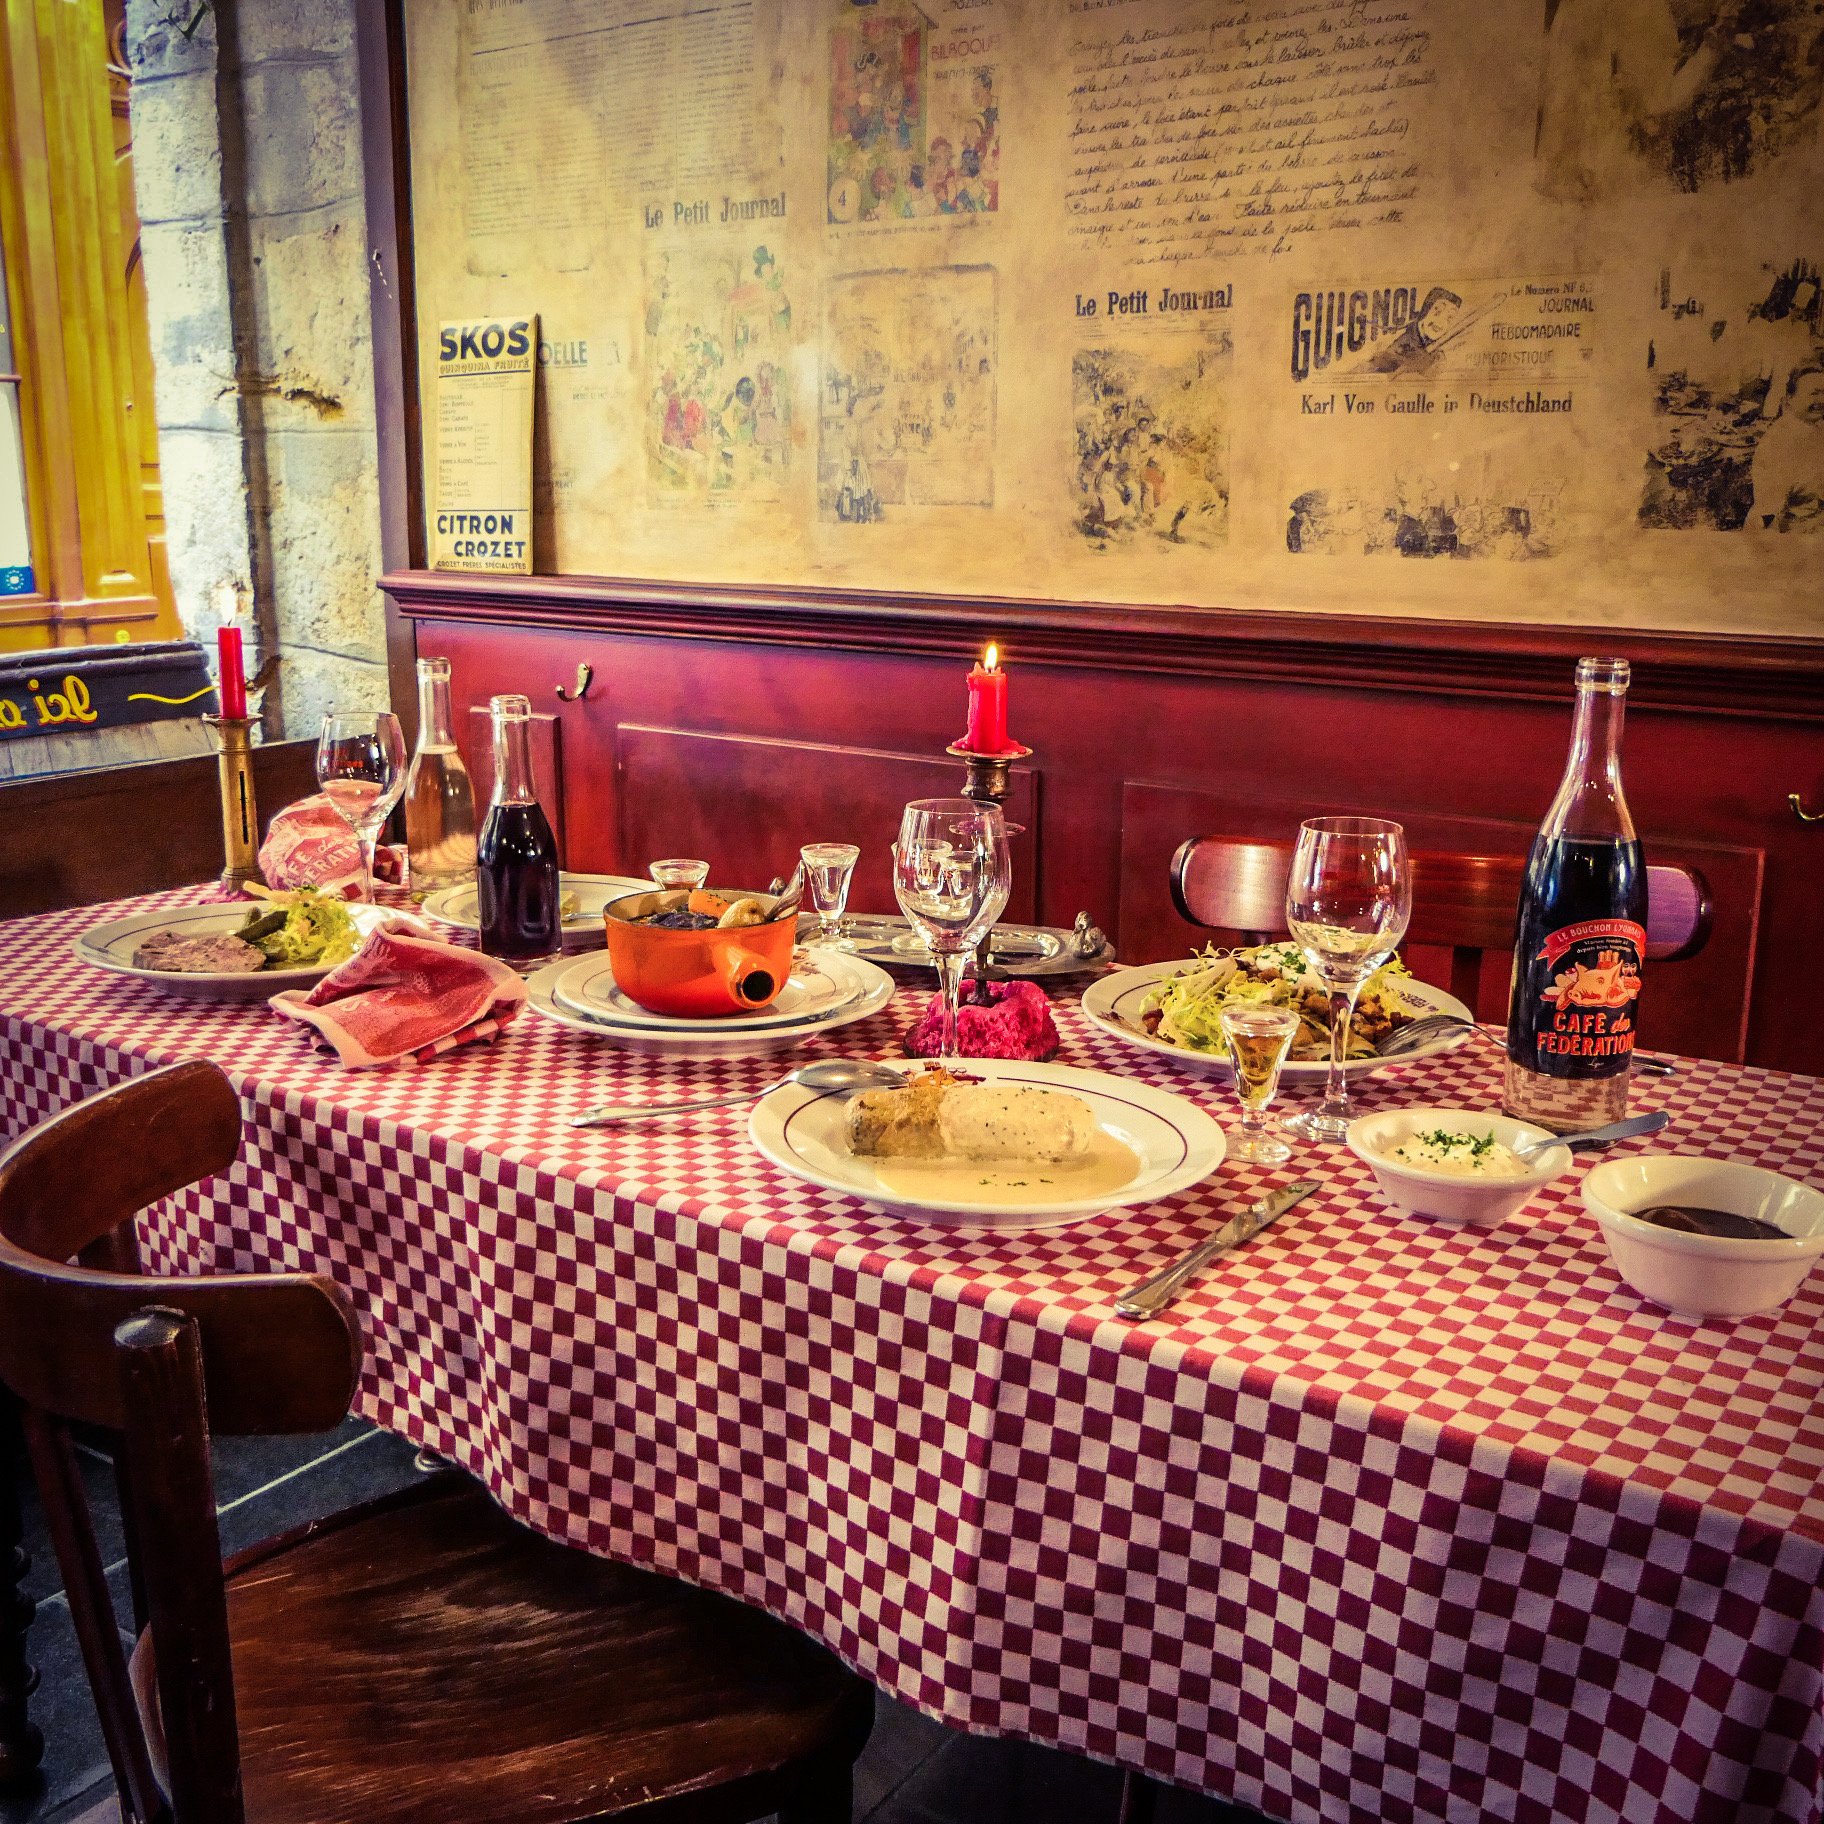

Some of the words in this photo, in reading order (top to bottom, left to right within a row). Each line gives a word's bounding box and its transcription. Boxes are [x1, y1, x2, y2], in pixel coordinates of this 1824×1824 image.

[645, 205, 664, 229] Le
[674, 199, 710, 224] Petit
[720, 191, 786, 222] Journal
[1075, 293, 1097, 318] Le
[1107, 289, 1148, 316] Petit
[1158, 282, 1234, 313] Journal
[1538, 297, 1595, 314] JOURNAL
[440, 321, 531, 362] SKOS
[1290, 286, 1420, 383] GUIGNOL
[1490, 321, 1582, 341] HEBDOMADAIRE
[1300, 394, 1335, 415] Karl
[1344, 393, 1376, 414] Von
[1385, 392, 1435, 414] Gaulle
[1444, 393, 1459, 414] in
[1469, 390, 1573, 415] Deustchland
[437, 514, 514, 535] CITRON
[453, 540, 527, 559] CROZET
[436, 560, 461, 569] CROZET
[1557, 931, 1569, 943] LE
[1569, 923, 1612, 938] BOUCHON
